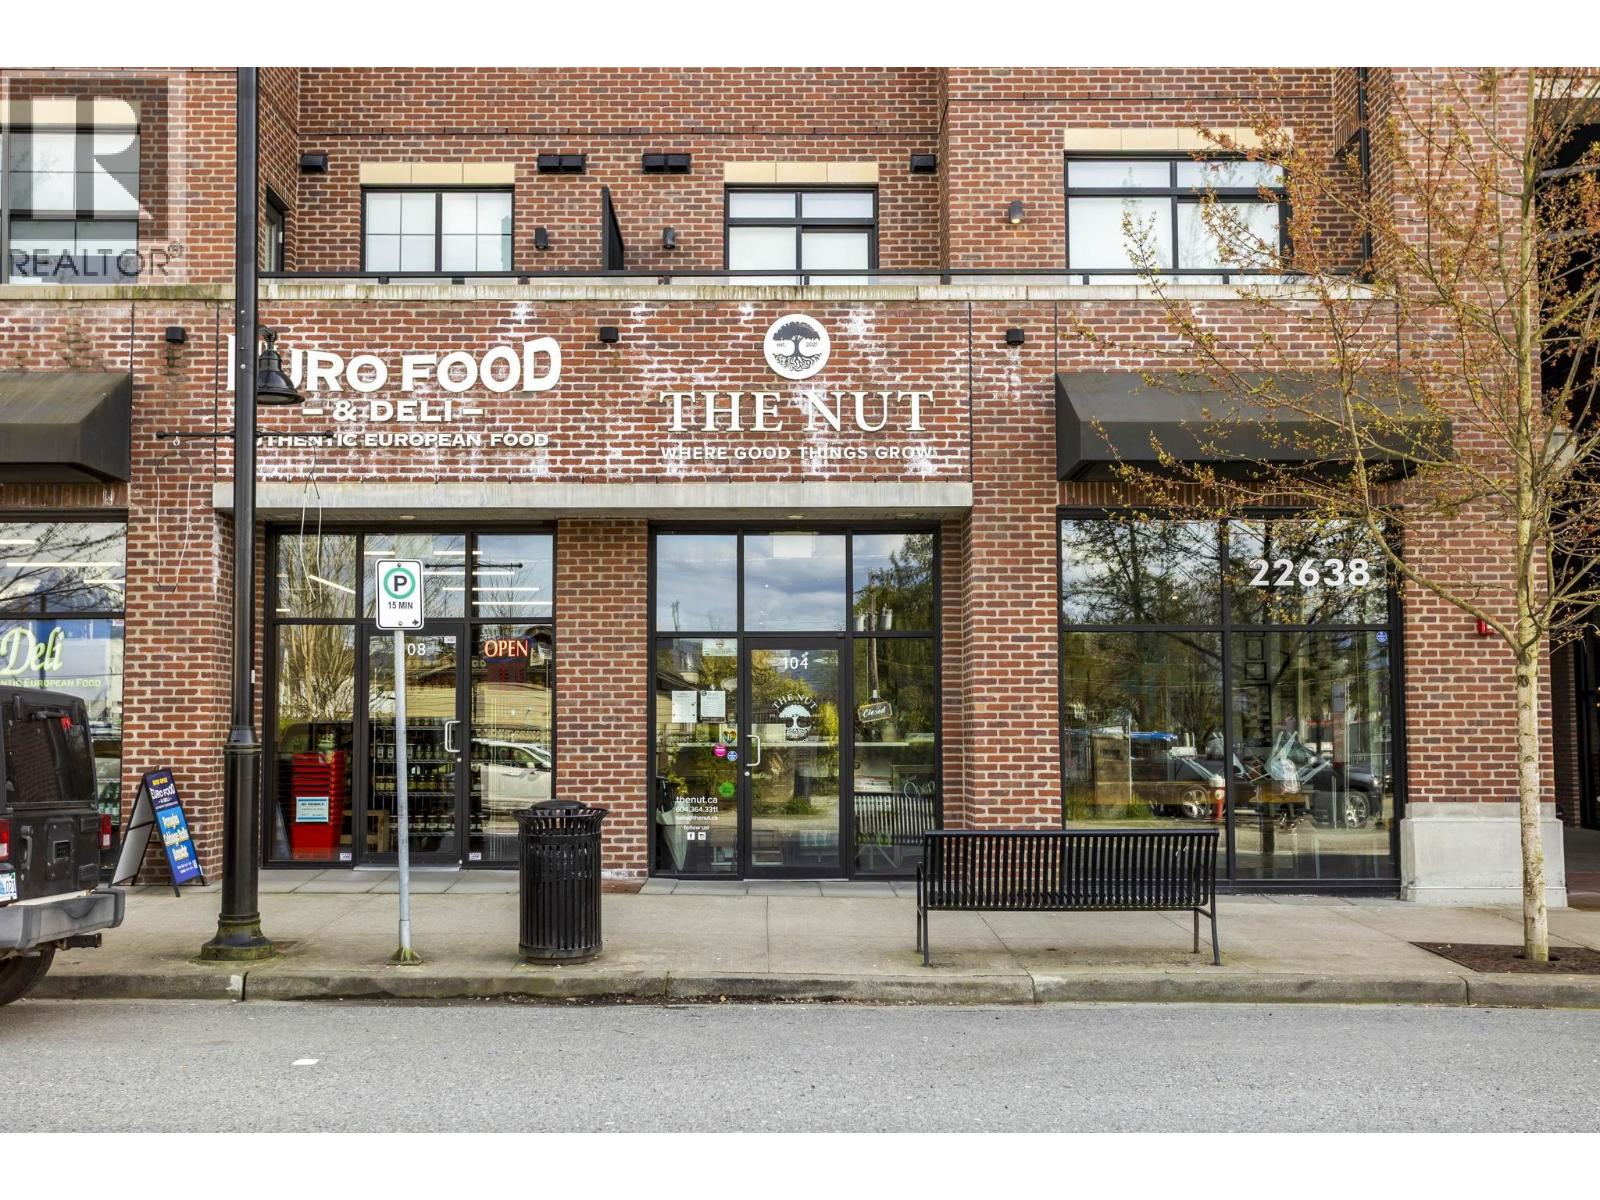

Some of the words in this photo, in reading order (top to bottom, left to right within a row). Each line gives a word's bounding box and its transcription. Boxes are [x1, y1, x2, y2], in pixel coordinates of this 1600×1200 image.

[401, 336, 562, 393] FOOD
[332, 400, 357, 422] &
[369, 400, 452, 422] DELI
[659, 390, 784, 432] THE
[803, 390, 934, 432] NUT
[364, 432, 481, 447] EUROPEAN
[490, 432, 549, 447] FOOD
[660, 446, 727, 460] WHERE
[734, 446, 791, 460] GOOD
[797, 446, 868, 460] THINGS
[1249, 558, 1370, 587] 22638
[394, 575, 407, 592] P
[387, 601, 397, 610] 15
[398, 601, 414, 610] MIN
[0, 626, 65, 676] Deli
[407, 642, 426, 656] 08
[483, 639, 529, 658] OPEN
[782, 656, 809, 670] 104
[23, 677, 74, 688] EUROPEAN
[75, 677, 101, 689] FOOD
[771, 692, 794, 710] THE
[797, 692, 818, 710] NUT
[862, 705, 886, 718] Closed
[675, 796, 718, 804] thenut.ca
